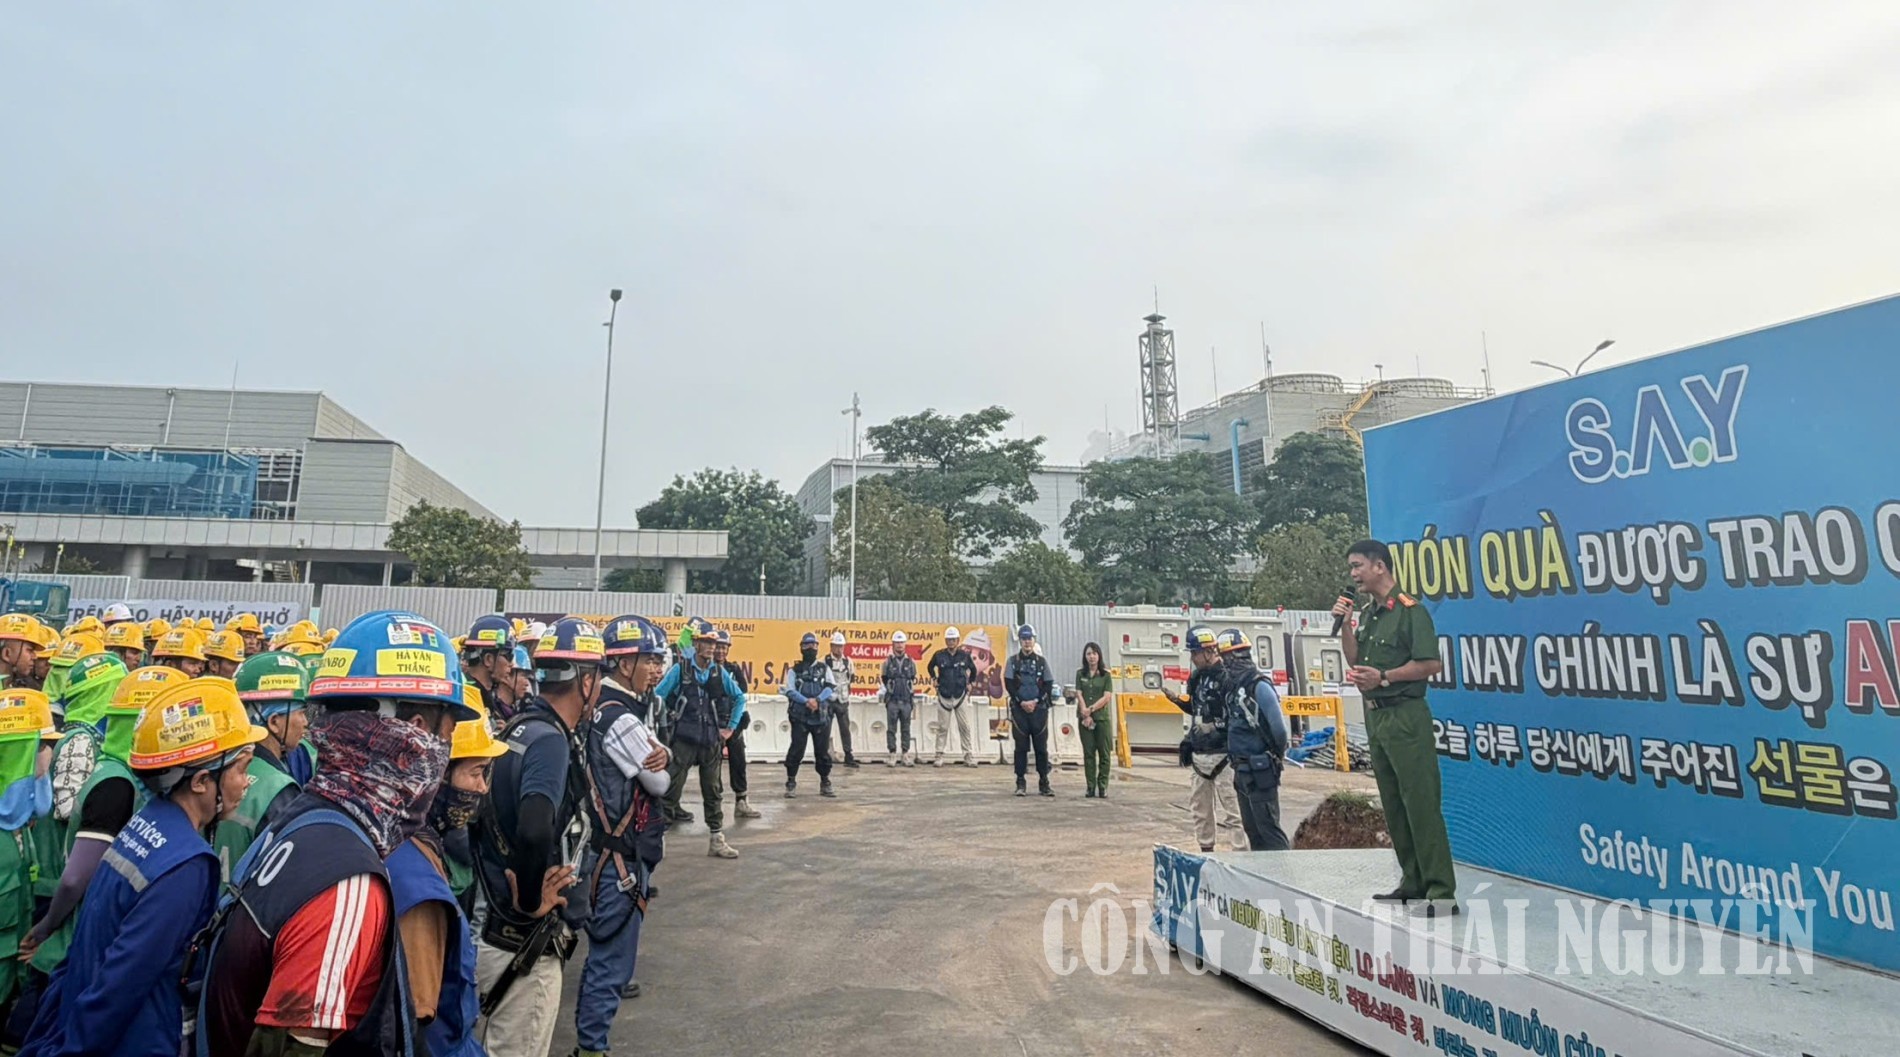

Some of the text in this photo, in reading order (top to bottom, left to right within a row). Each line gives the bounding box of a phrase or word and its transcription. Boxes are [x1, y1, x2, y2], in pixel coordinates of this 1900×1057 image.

[1388, 525, 1469, 597] MÓN
[1479, 510, 1571, 597] QUÀ
[1577, 522, 1699, 600] ĐƯỢC
[1708, 507, 1857, 582] TRAO
[160, 605, 195, 623] HÃY
[198, 604, 244, 625] NHẮ
[848, 629, 865, 640] TRA
[850, 645, 871, 657] XÁC
[1459, 635, 1521, 687] NAY
[1533, 622, 1659, 694] CHÍNH
[1669, 620, 1736, 698] LÀ
[1746, 632, 1823, 719] SỰ
[1298, 702, 1321, 712] FIRST
[1474, 722, 1520, 762] 하루
[1526, 727, 1633, 778] 당신에게
[1640, 737, 1739, 791] 주어진
[1749, 739, 1892, 811] 선물은
[127, 814, 168, 849] ervices
[1578, 822, 1896, 931] Safety Around You
[1355, 947, 1375, 983] LO
[1418, 975, 1441, 1010] VÀ
[1441, 982, 1498, 1036] MONG
